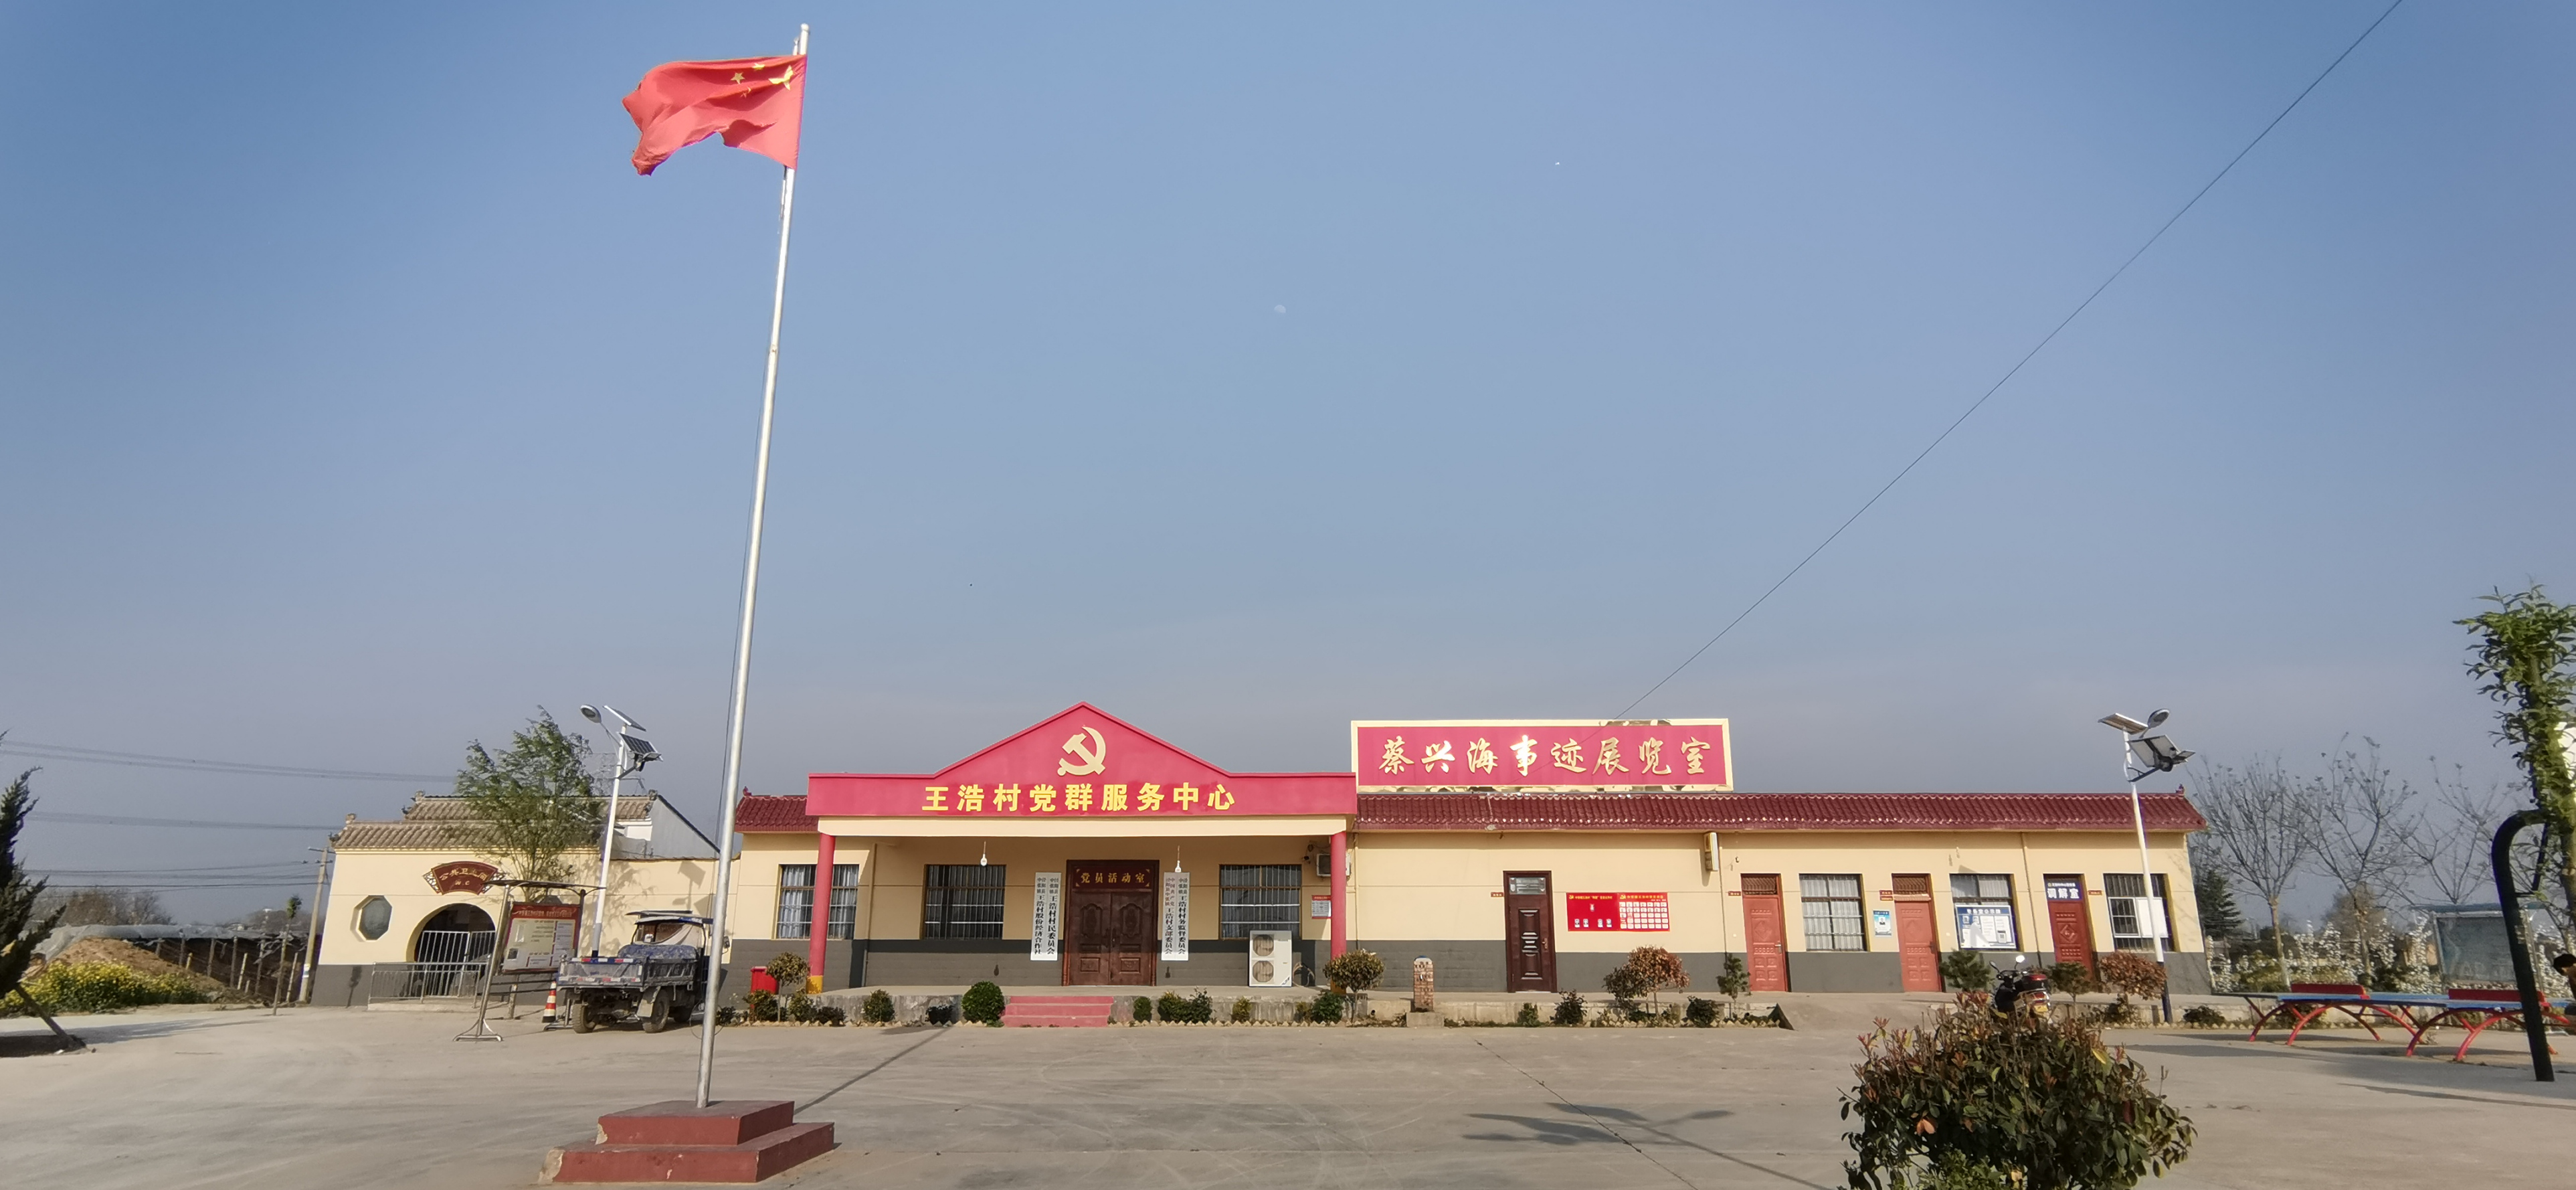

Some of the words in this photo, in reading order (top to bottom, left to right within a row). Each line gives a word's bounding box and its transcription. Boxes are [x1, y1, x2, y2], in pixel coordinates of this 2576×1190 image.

[1379, 736, 1711, 776] 蔡兴海事迹展览室
[922, 782, 1235, 812] 王浩村党群服务中心
[1081, 873, 1145, 883] 党员活动室
[2047, 888, 2080, 899] 调解室
[1047, 896, 1058, 954] 王浩村村民委员会
[1165, 908, 1174, 954] 王浩村支部委员会
[1178, 896, 1187, 954] 王浩村村务监督委员会
